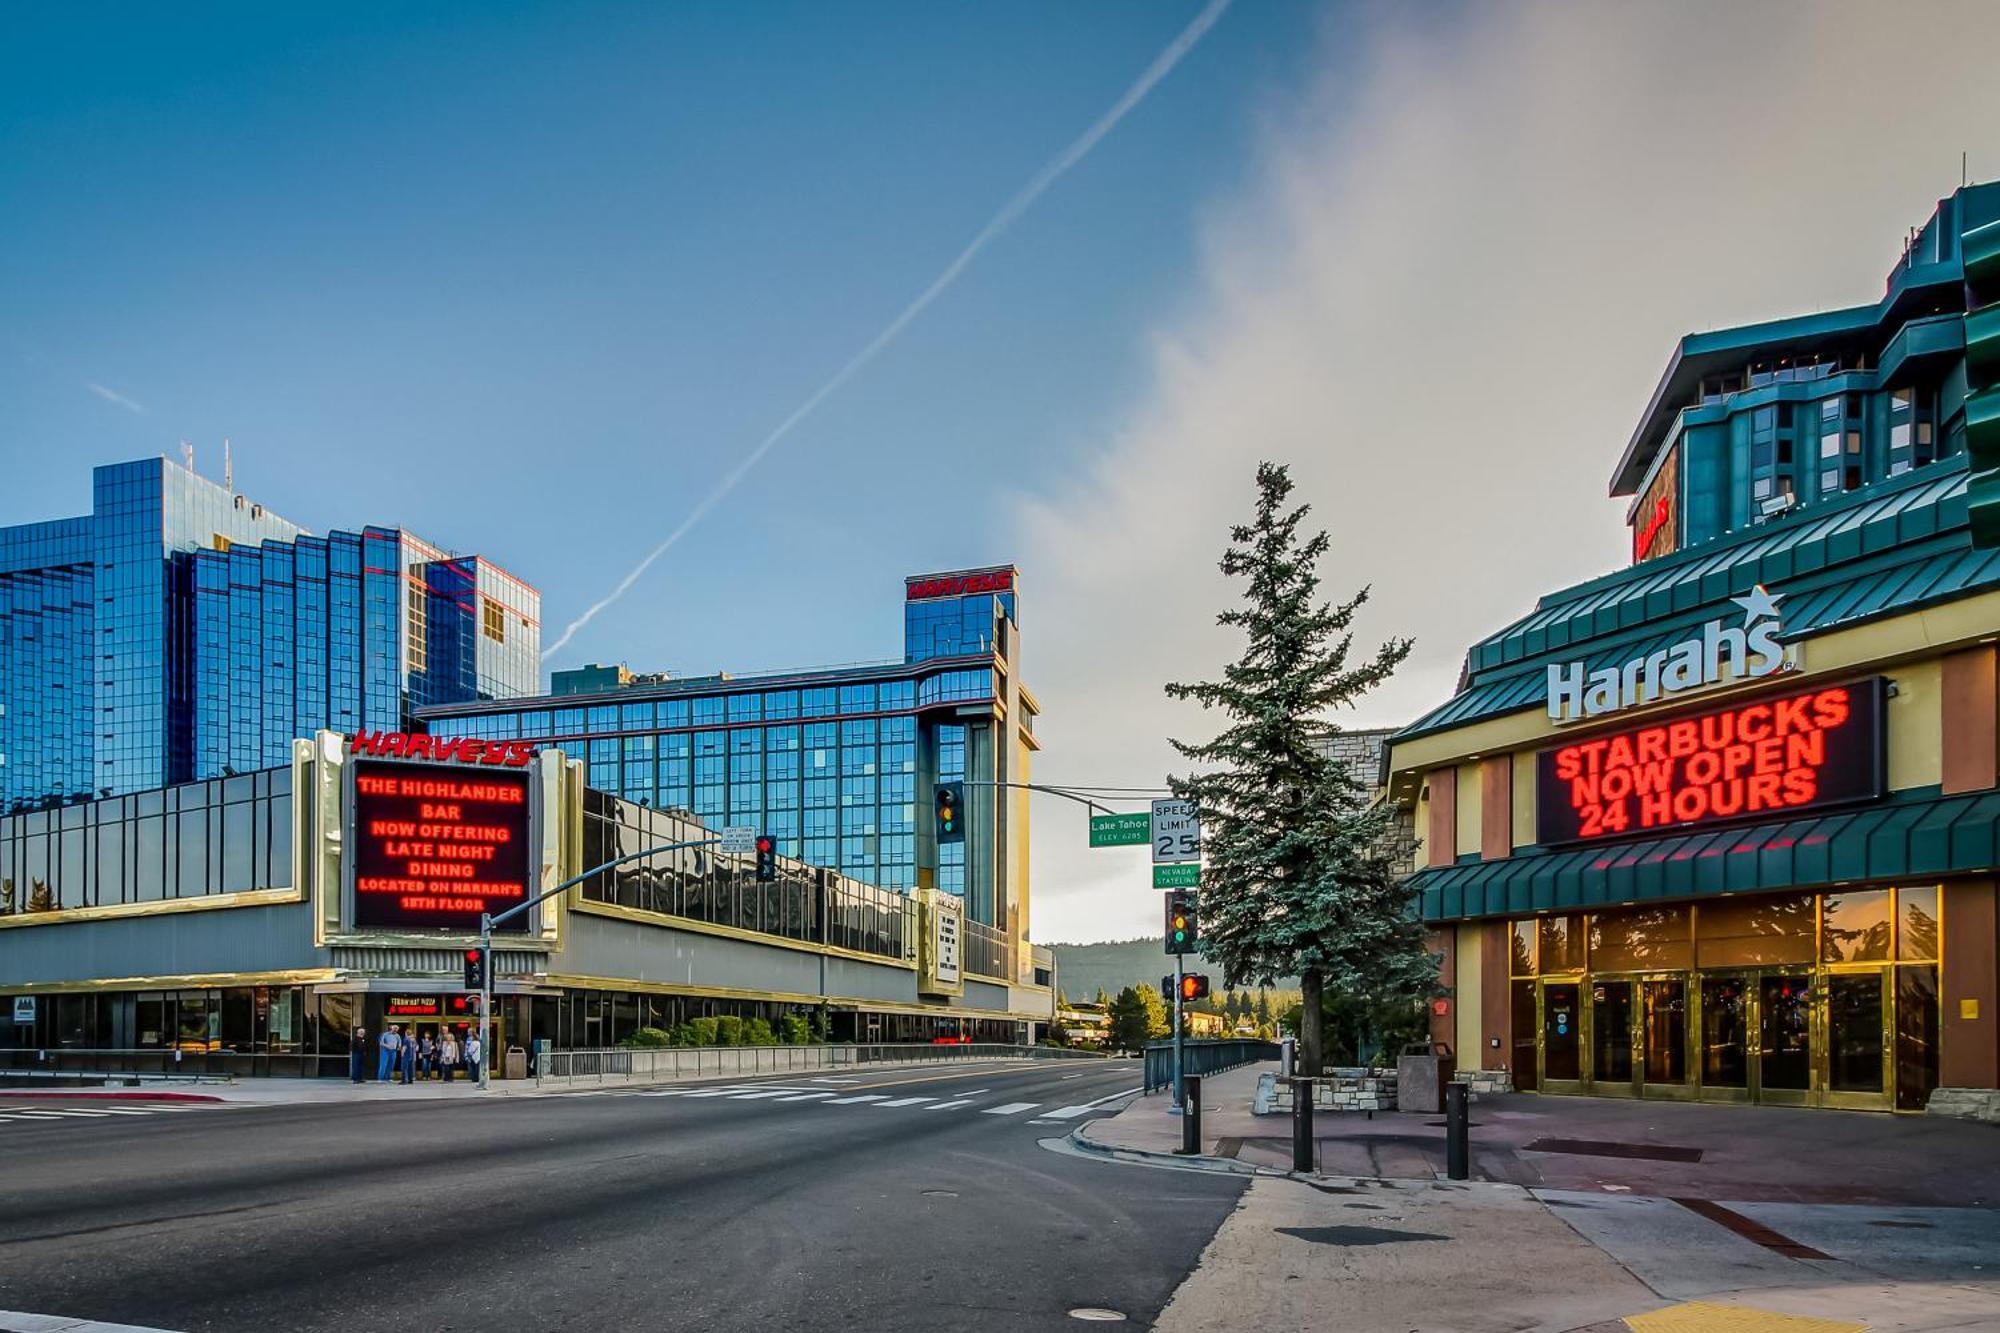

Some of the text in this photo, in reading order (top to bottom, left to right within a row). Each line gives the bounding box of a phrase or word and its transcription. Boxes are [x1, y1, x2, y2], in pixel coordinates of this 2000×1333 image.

[1555, 688, 1850, 780] STARBUCKS
[1571, 729, 1825, 808] NOW OPEN
[358, 777, 523, 803] THE HIGHLANDER
[1155, 804, 1196, 817] SPEED
[1578, 767, 1817, 837] 24 HOURS
[420, 803, 461, 820] BAR
[371, 821, 510, 842] NOW OFFERING
[1091, 819, 1148, 831] Lake Tahoe
[1160, 820, 1191, 831] LIMIT
[385, 842, 496, 860] LATE NIGHT
[1158, 834, 1197, 856] 25
[408, 862, 475, 878] DINING
[1162, 868, 1192, 876] NEVADA
[359, 878, 523, 896] LOCATED ON HARRAH'S
[1157, 876, 1198, 885] STATELINE
[439, 898, 485, 911] FLOOR
